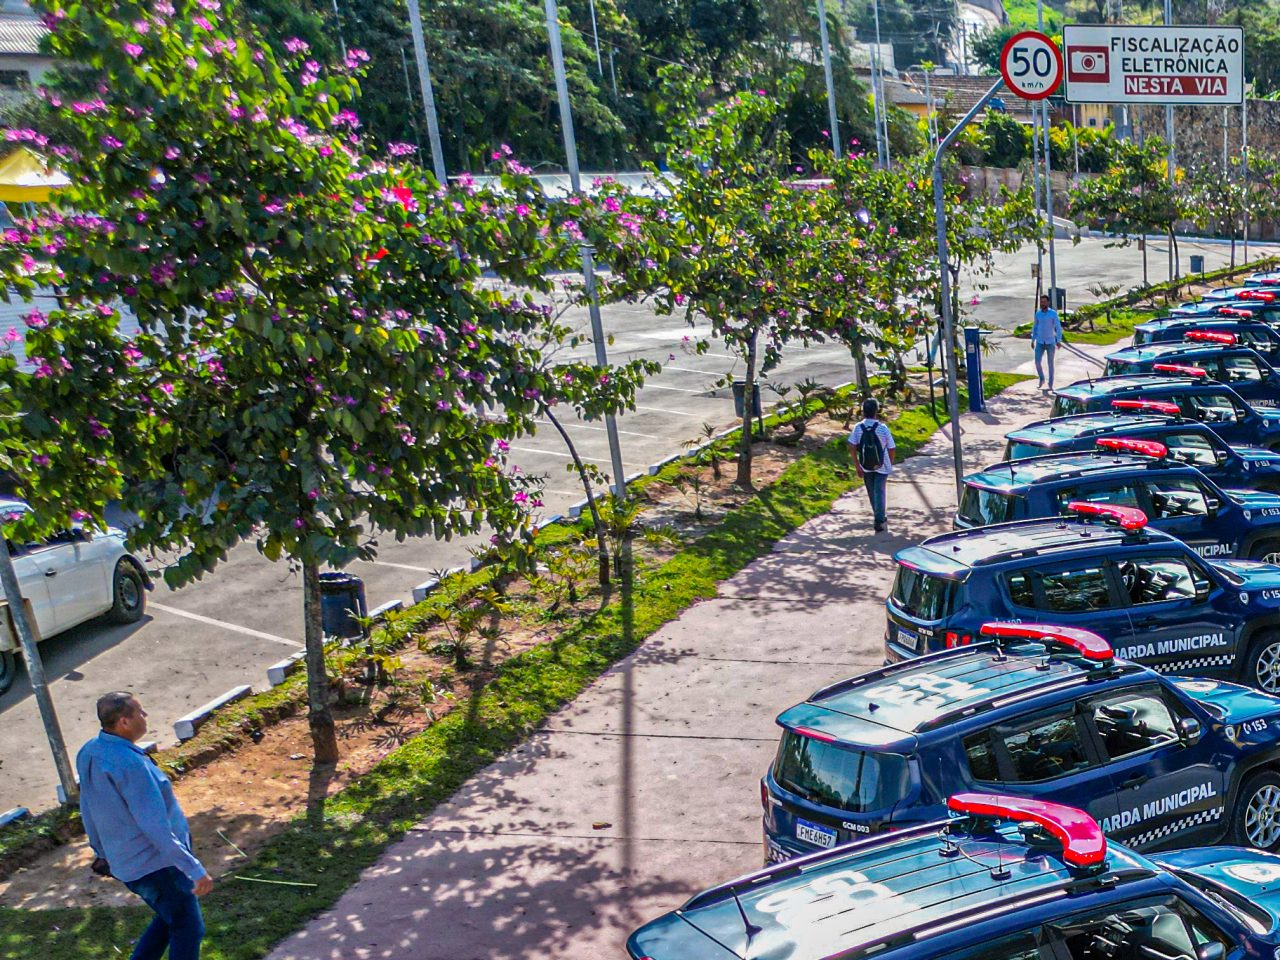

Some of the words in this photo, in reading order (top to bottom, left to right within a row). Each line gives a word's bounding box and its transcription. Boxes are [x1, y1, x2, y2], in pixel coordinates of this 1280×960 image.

[1111, 34, 1239, 57] FISCALIZAÇÃO
[1012, 46, 1052, 77] 50
[1121, 52, 1229, 73] ELETRÔNICA
[1021, 81, 1044, 89] km/h
[1125, 77, 1184, 94] NESTA
[1194, 77, 1225, 94] VIA
[1268, 508, 1280, 516] 153
[1192, 543, 1233, 557] NICIPAL
[1115, 643, 1156, 660] ARDA
[1157, 633, 1228, 655] MUNICIPAL
[1251, 718, 1268, 732] 153
[1098, 807, 1141, 834] ARDA
[1143, 781, 1217, 820] MUNICIPAL
[799, 826, 832, 847] FME6H57
[842, 821, 856, 832] GCM
[856, 823, 870, 834] 003
